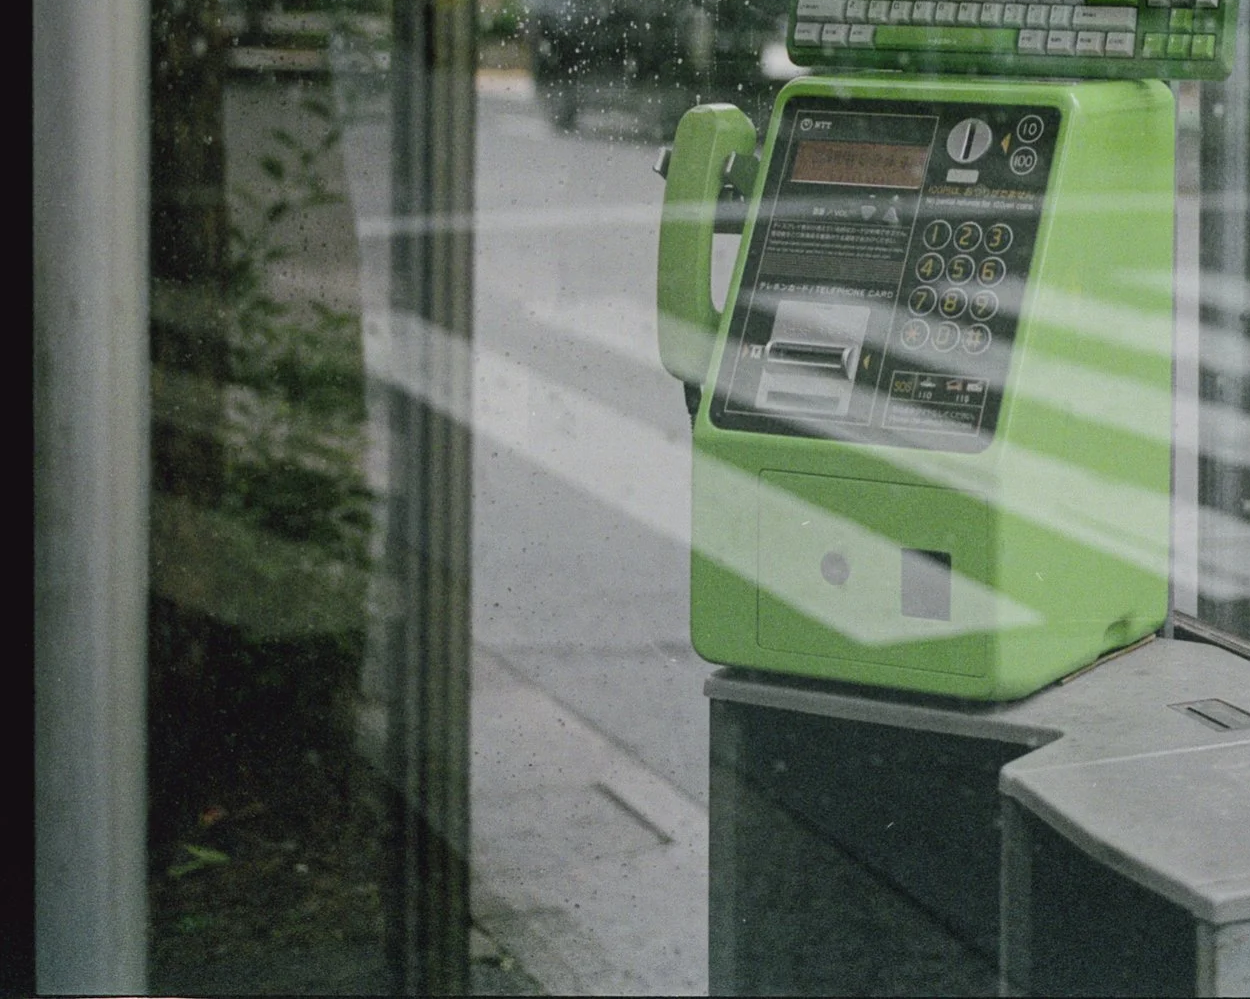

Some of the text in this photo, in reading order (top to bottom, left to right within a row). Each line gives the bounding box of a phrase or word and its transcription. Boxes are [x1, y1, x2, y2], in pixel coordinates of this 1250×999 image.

[1022, 121, 1038, 136] 10
[1013, 153, 1033, 169] 100
[931, 224, 939, 244] 1
[958, 226, 973, 246] 2
[988, 227, 1003, 248] 3
[919, 257, 996, 282] 4 5 6
[915, 290, 990, 315] 7 8 9
